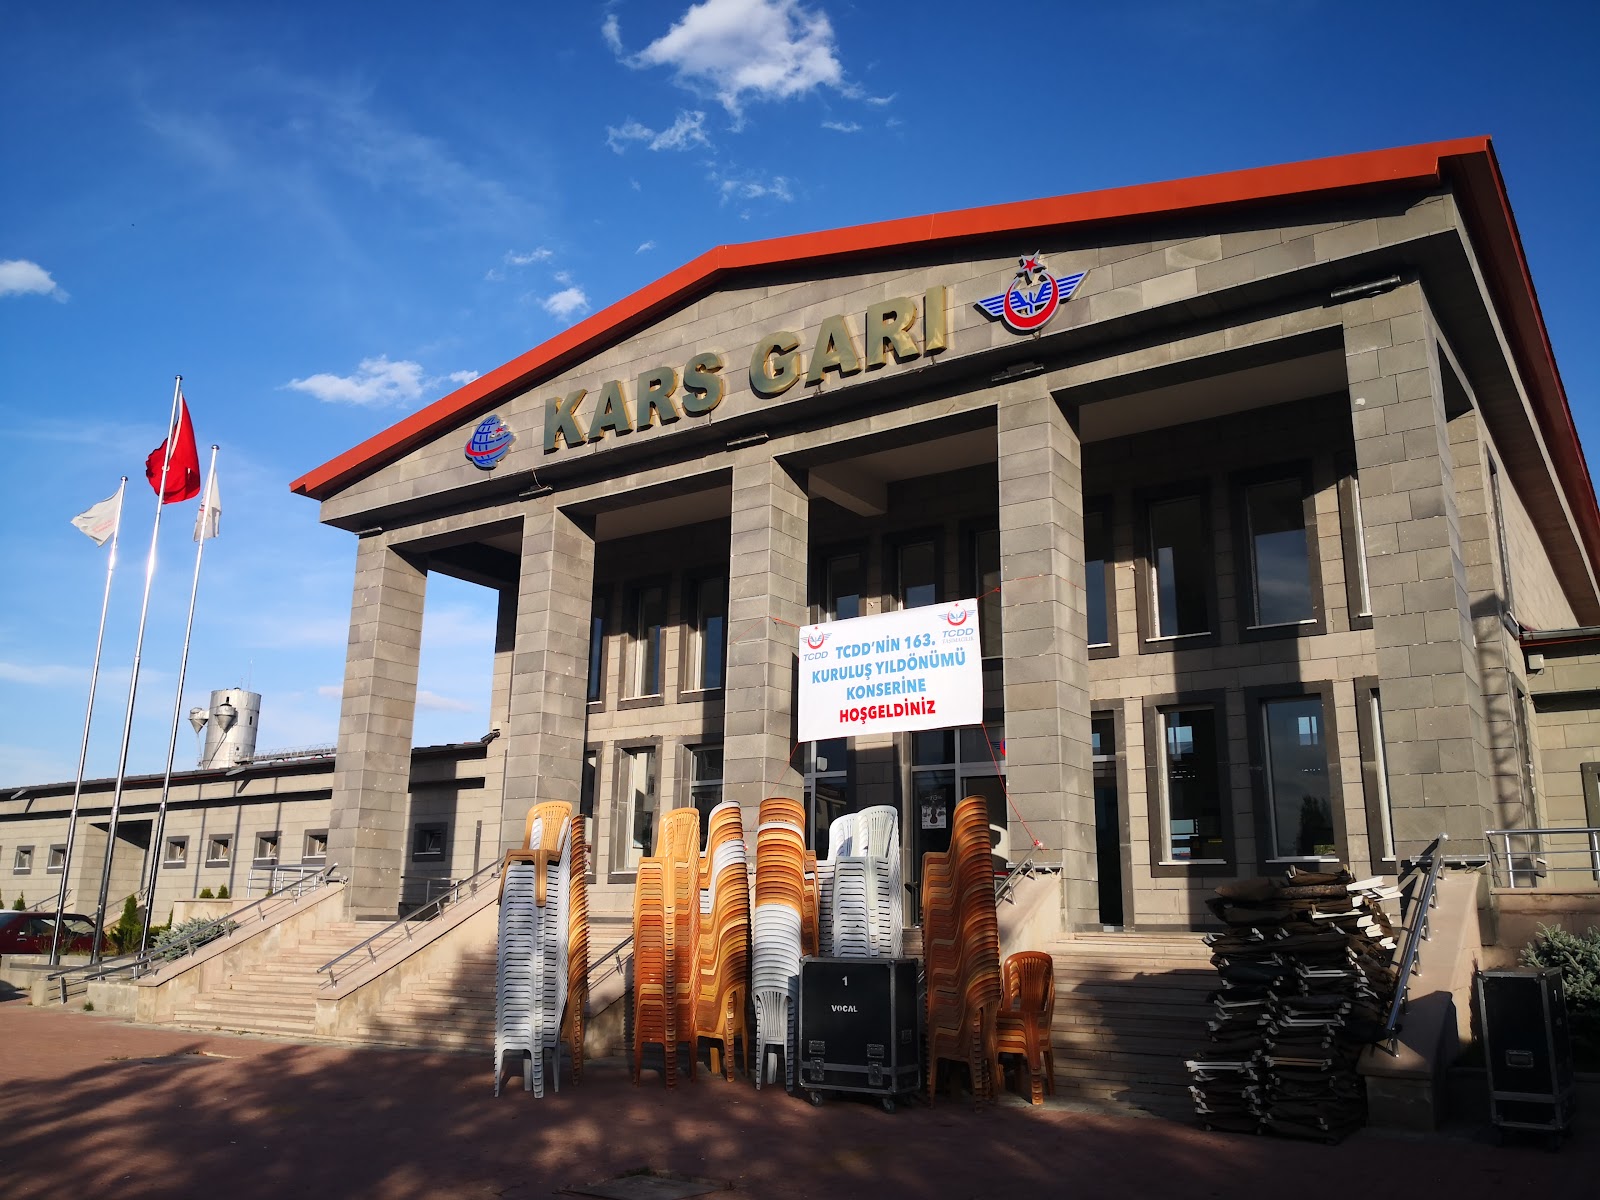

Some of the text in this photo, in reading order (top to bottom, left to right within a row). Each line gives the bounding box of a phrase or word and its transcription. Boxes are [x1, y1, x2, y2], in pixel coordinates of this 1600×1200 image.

[543, 284, 948, 455] KARS GARI
[904, 633, 936, 649] 163.
[942, 628, 974, 638] TCDD
[803, 651, 829, 662] TCDD
[812, 647, 966, 684] KURULUŞ YILDÖNÜMÜ
[846, 676, 927, 700] KONSERİNE
[839, 697, 936, 724] HOŞGELDİNİZ
[842, 975, 848, 986] 1
[831, 1004, 858, 1013] VOCAL
